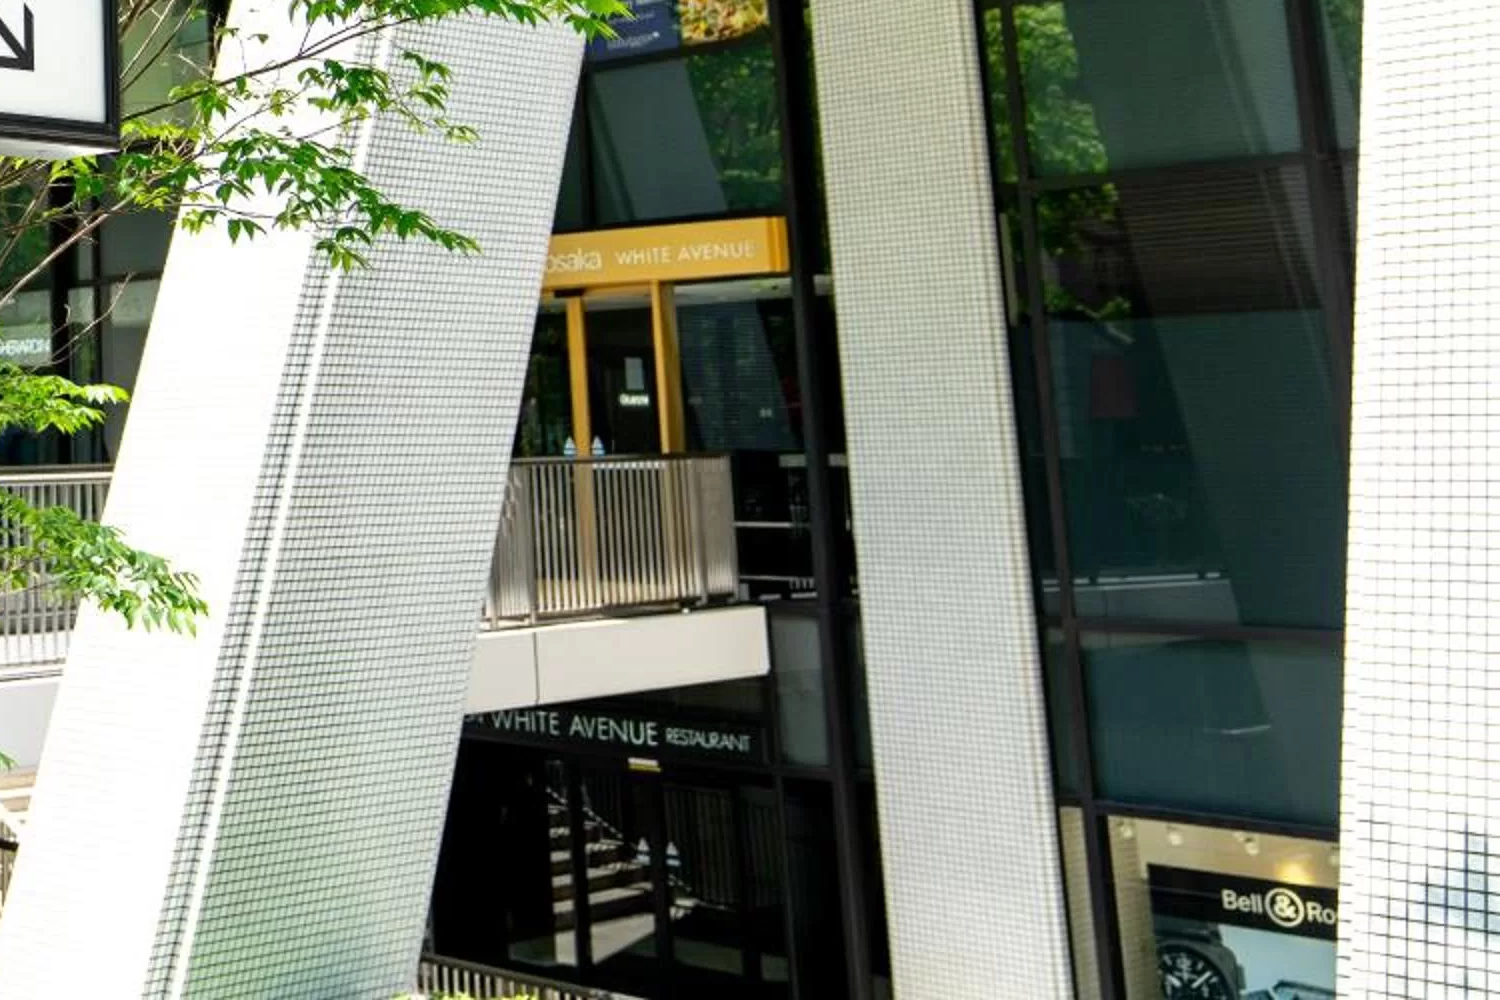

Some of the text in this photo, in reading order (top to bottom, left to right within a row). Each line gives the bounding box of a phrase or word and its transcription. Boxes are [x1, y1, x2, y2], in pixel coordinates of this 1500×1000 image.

[614, 247, 674, 265] WHITE
[677, 239, 756, 261] AVENUE
[492, 710, 752, 752] WHITE AVENUE RESTAURANT
[1221, 889, 1263, 914] Bell
[1306, 901, 1338, 925] Ro
